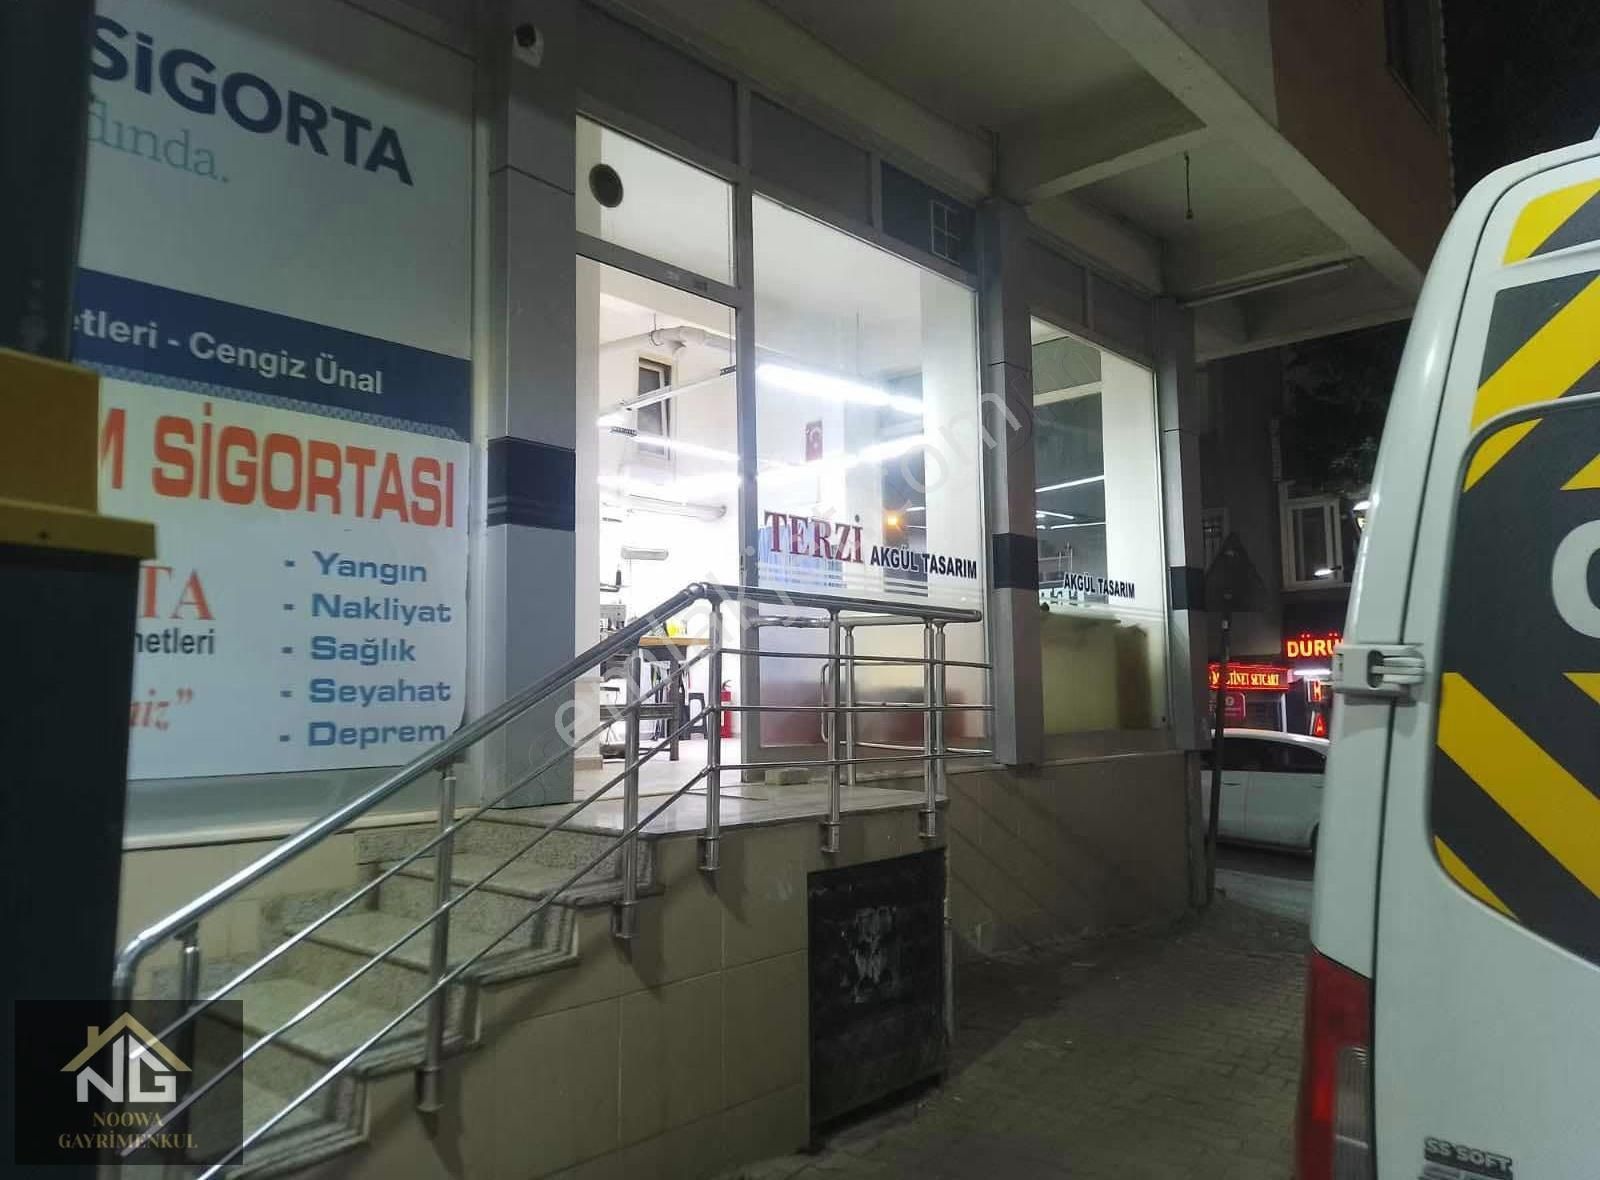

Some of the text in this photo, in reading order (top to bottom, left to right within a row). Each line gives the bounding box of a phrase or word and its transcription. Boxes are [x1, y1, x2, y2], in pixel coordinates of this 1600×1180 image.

[73, 308, 158, 350] tleri
[189, 330, 306, 380] Cengiz
[315, 352, 383, 395] Ünal
[151, 401, 455, 529] SİGORTASI
[763, 509, 978, 581] TERZİ AKGÜL TASARIM
[313, 550, 428, 585] Yangın
[1063, 571, 1136, 600] AKGÜL TASARIM
[311, 592, 452, 625] Nakliyat
[310, 635, 416, 667] Sağlık
[1287, 632, 1344, 658] DÜRÜ
[308, 677, 451, 708] Seyahat
[308, 720, 447, 750] Deprem
[1456, 1145, 1512, 1172] SOFT
